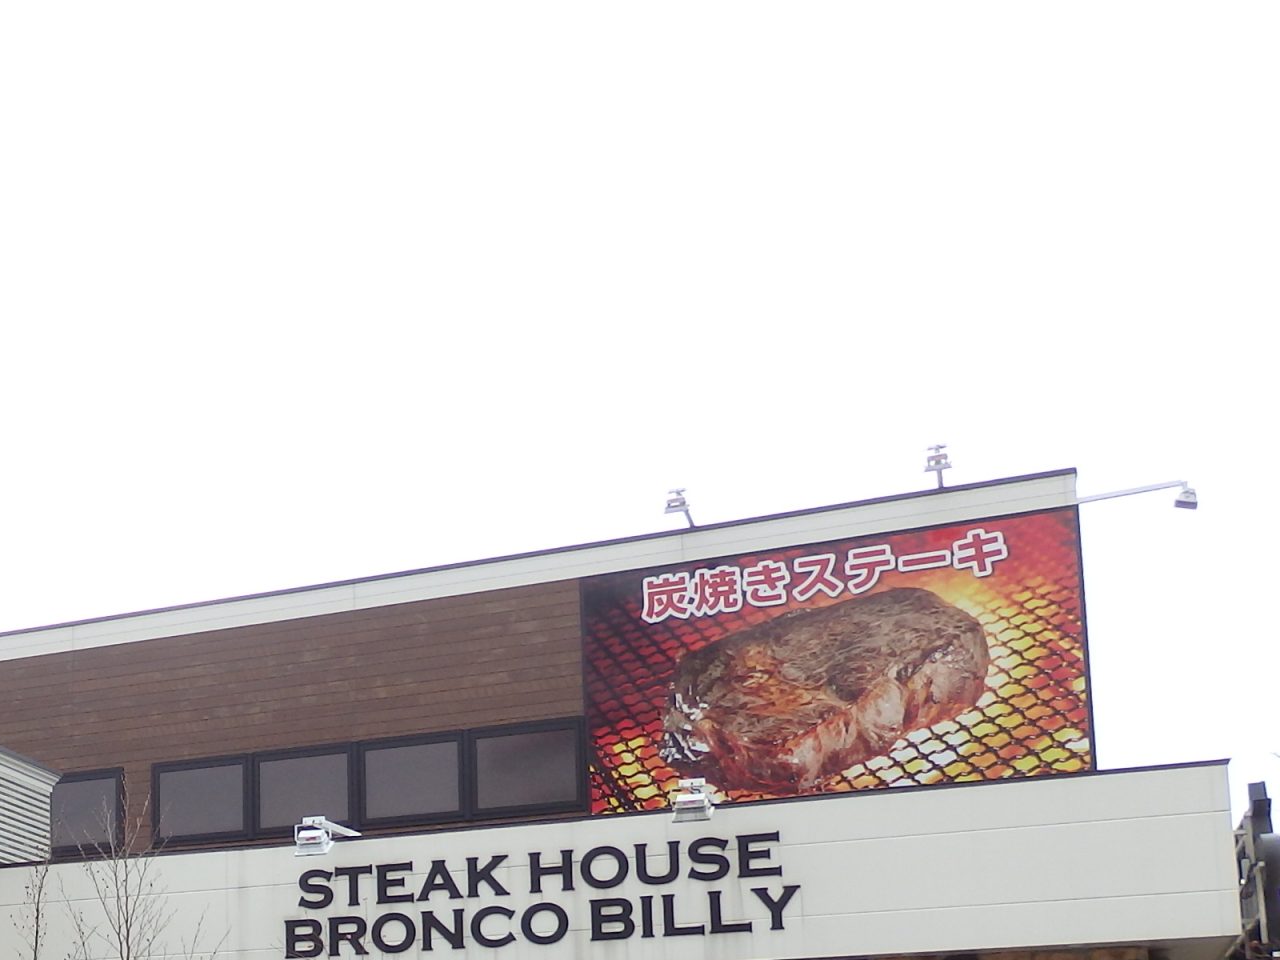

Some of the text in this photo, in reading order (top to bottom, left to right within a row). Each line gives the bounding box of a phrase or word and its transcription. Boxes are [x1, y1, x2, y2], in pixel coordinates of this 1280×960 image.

[641, 528, 1008, 623] 炭焼きステーキ
[298, 831, 783, 909] STEAK HOUSE
[284, 885, 801, 959] BRONCO BILLY
